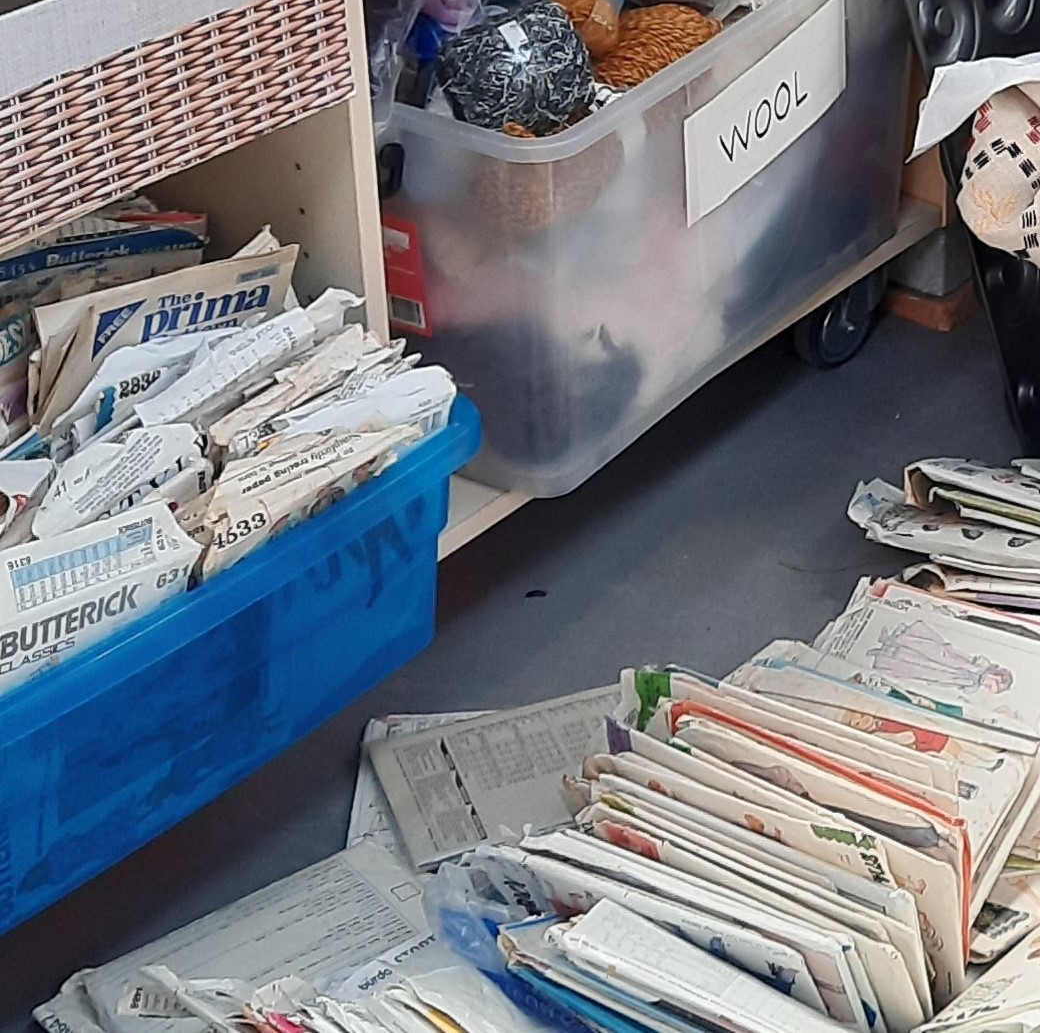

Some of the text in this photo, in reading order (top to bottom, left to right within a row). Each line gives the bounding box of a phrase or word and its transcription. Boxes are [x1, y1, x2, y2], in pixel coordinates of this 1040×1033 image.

[719, 71, 808, 162] WOOL
[139, 284, 270, 344] prima
[158, 294, 192, 308] The
[0, 582, 143, 659] BUTTERICK
